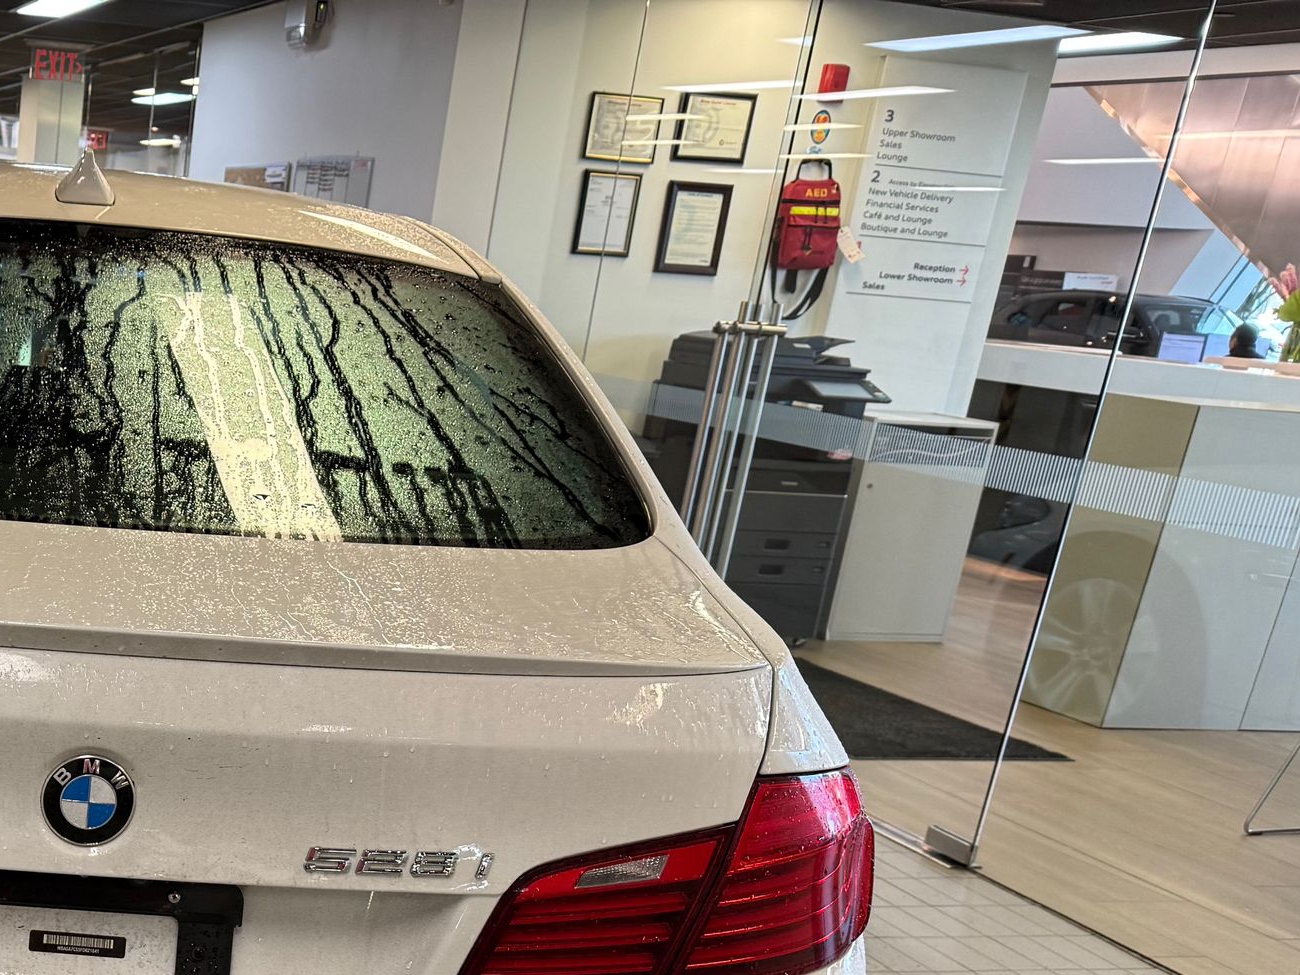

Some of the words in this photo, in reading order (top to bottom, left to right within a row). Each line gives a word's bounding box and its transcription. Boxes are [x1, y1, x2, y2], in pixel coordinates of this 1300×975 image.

[35, 49, 77, 81] EXIT
[884, 109, 895, 122] 3
[882, 127, 908, 138] Upper
[910, 130, 956, 142] Showroom
[879, 139, 902, 149] Sales
[876, 151, 908, 163] Lounge
[871, 170, 881, 183] 2
[805, 188, 828, 197] AED
[868, 187, 888, 197] New
[889, 189, 919, 199] Vehicle
[920, 191, 954, 204] Delivery
[865, 198, 903, 210] Financial
[905, 202, 939, 213] Services
[863, 210, 882, 219] Café
[884, 213, 900, 221] and
[902, 214, 933, 225] Lounge
[860, 222, 898, 233] Boutique
[900, 226, 916, 234] and
[917, 228, 949, 239] Lounge
[913, 262, 956, 273] Reception
[879, 271, 905, 280] Lower
[907, 273, 953, 284] Showroom
[862, 281, 885, 290] Sales
[53, 758, 130, 790] BMW
[304, 846, 494, 881] 528i
